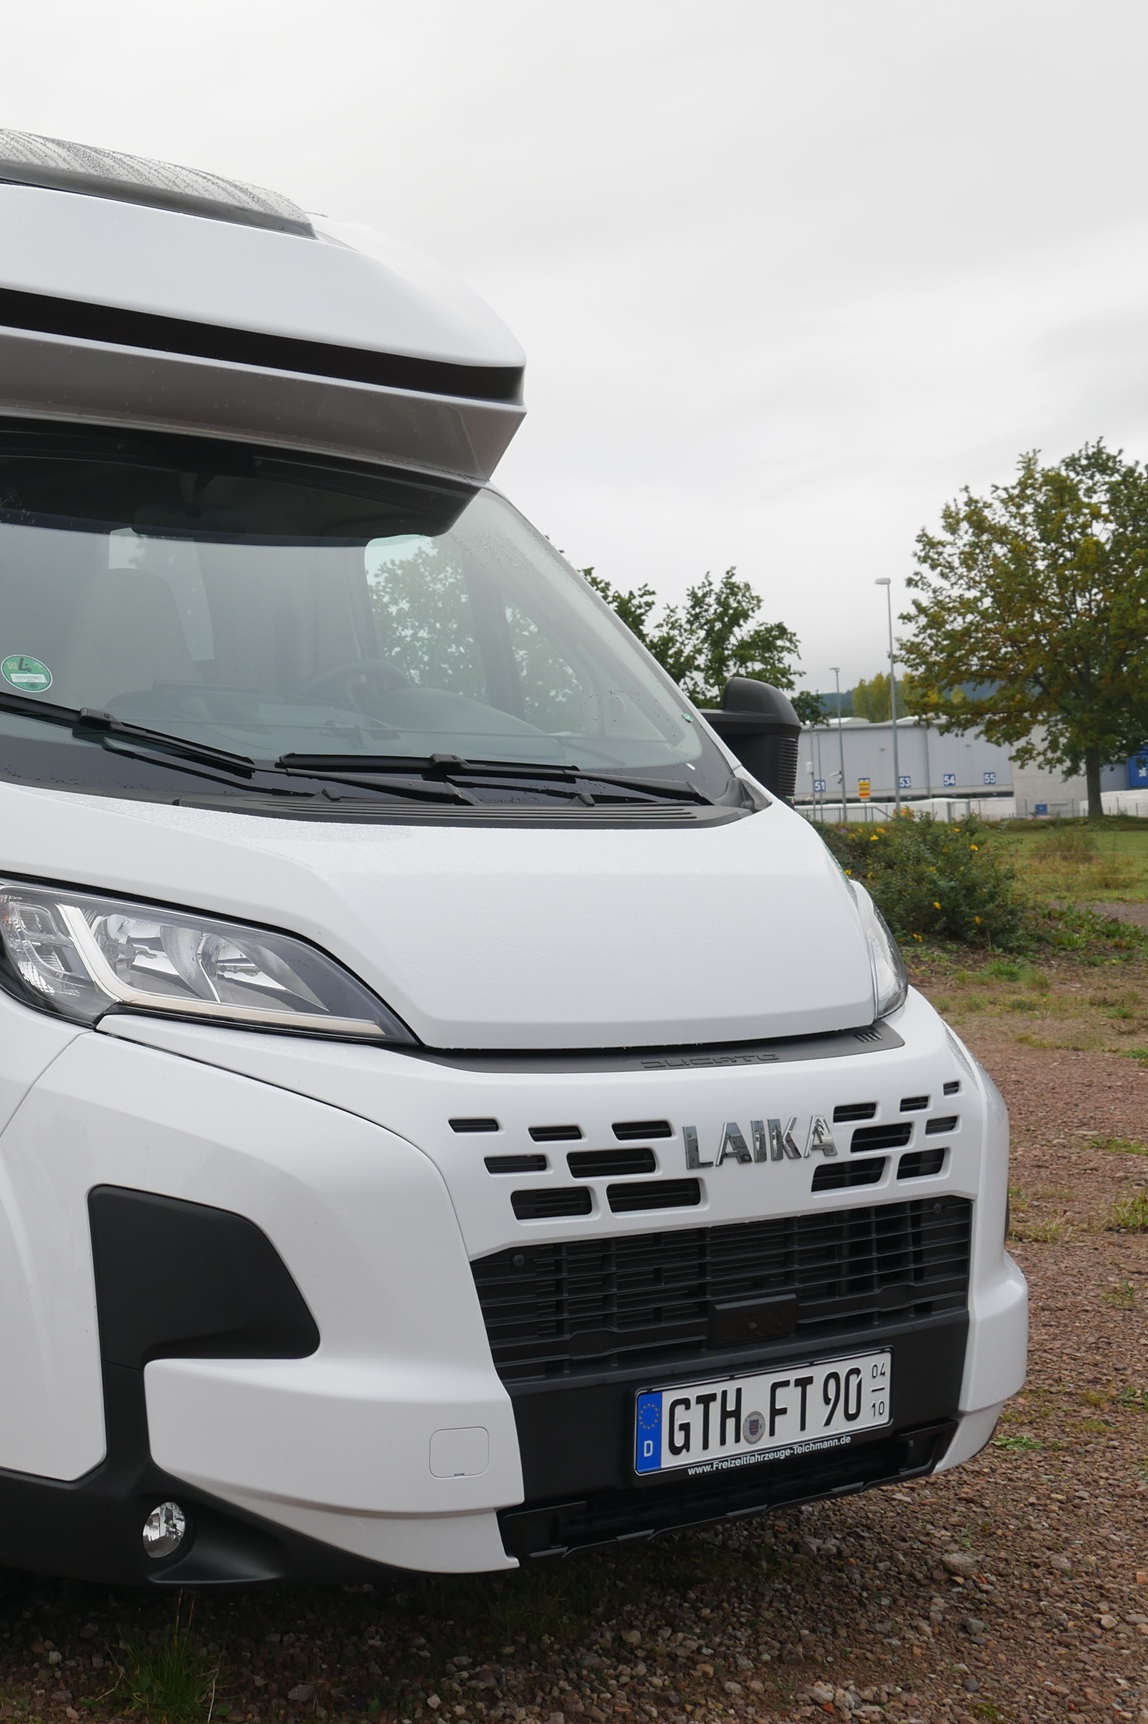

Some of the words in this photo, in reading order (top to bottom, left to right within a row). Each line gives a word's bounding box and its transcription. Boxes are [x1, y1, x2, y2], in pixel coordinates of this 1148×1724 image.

[814, 781, 825, 791] 51
[899, 777, 911, 787] 53
[943, 775, 956, 785] 54
[984, 773, 996, 784] 55
[682, 1114, 839, 1170] LAIKA
[871, 1362, 886, 1380] 04
[668, 1387, 742, 1456] GTH
[769, 1375, 814, 1437] FT
[822, 1366, 863, 1427] 90
[871, 1401, 885, 1418] 10
[643, 1440, 654, 1458] D
[687, 1435, 851, 1476] www.Freizeitfahrzeuge-Teichmann.de
